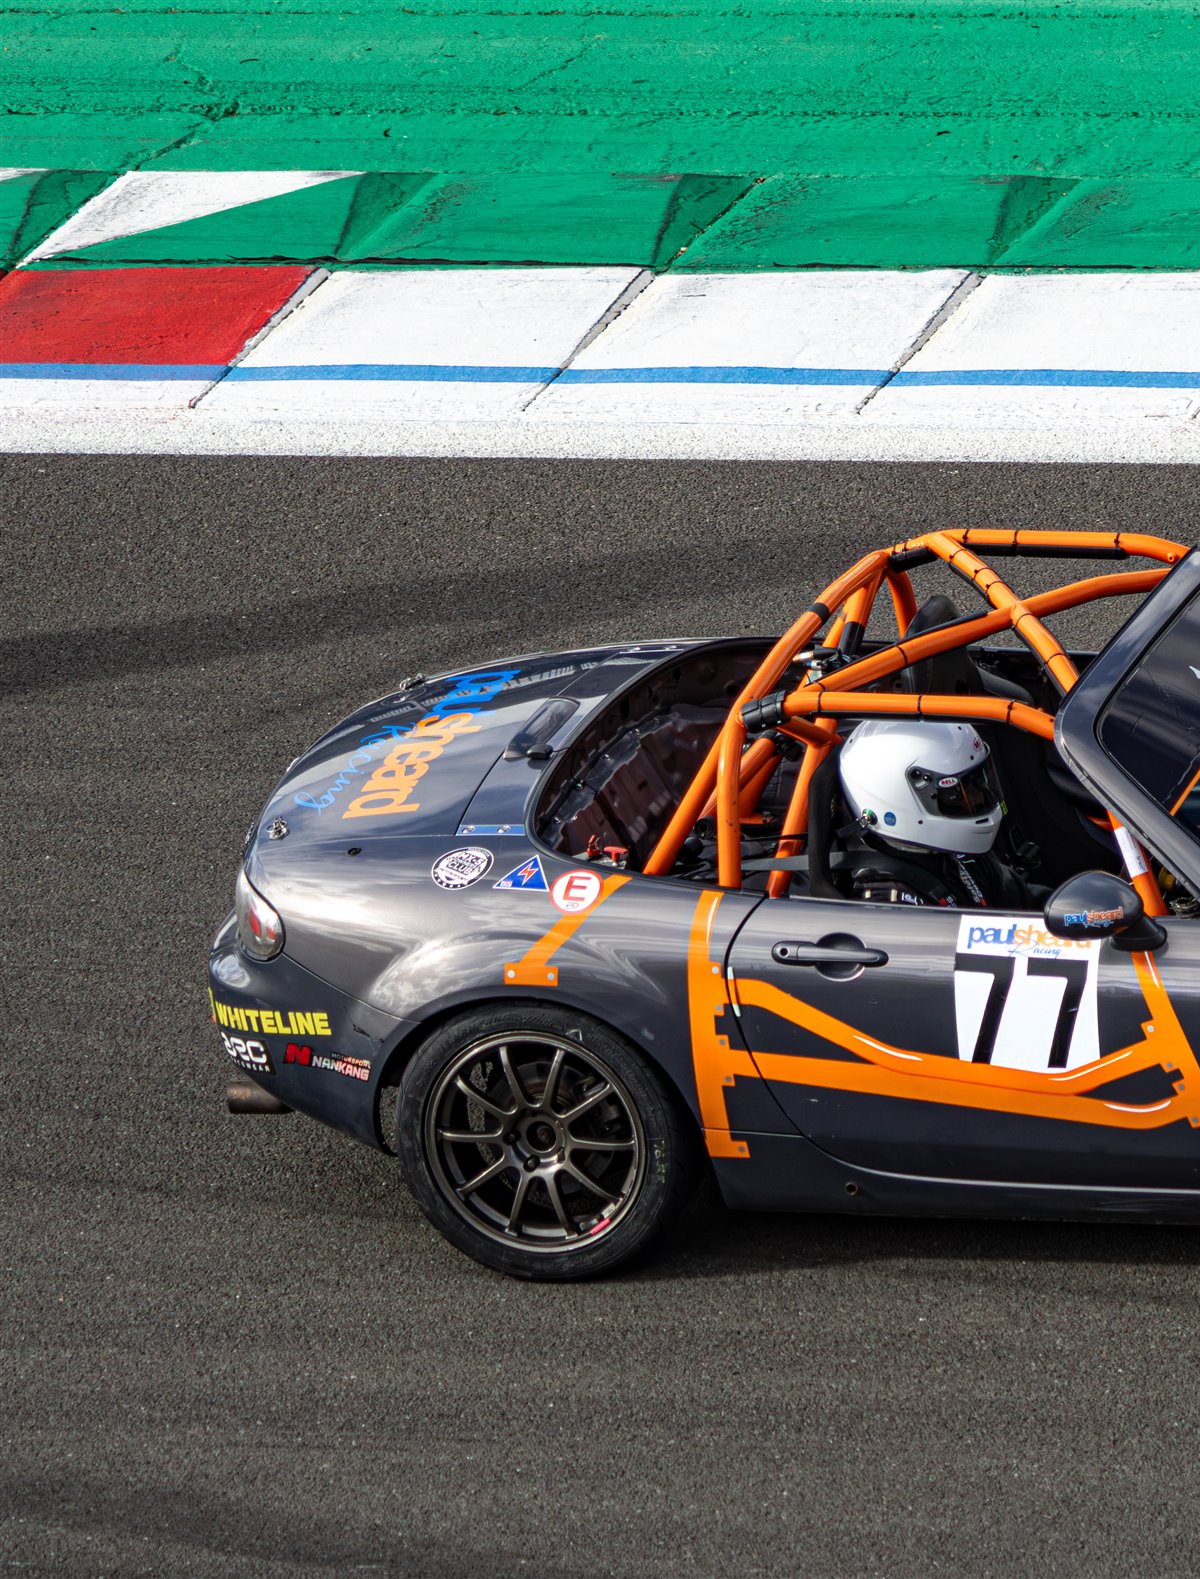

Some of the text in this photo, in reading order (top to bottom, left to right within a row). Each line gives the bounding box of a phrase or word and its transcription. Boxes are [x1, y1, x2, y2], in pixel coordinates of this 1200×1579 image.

[447, 861, 473, 875] CLUB
[457, 851, 485, 864] MX-5
[563, 875, 592, 902] E
[1007, 938, 1062, 960] Racing
[215, 1000, 332, 1036] WHITELINE
[954, 952, 1089, 1068] 77
[312, 1055, 370, 1082] NANKANG
